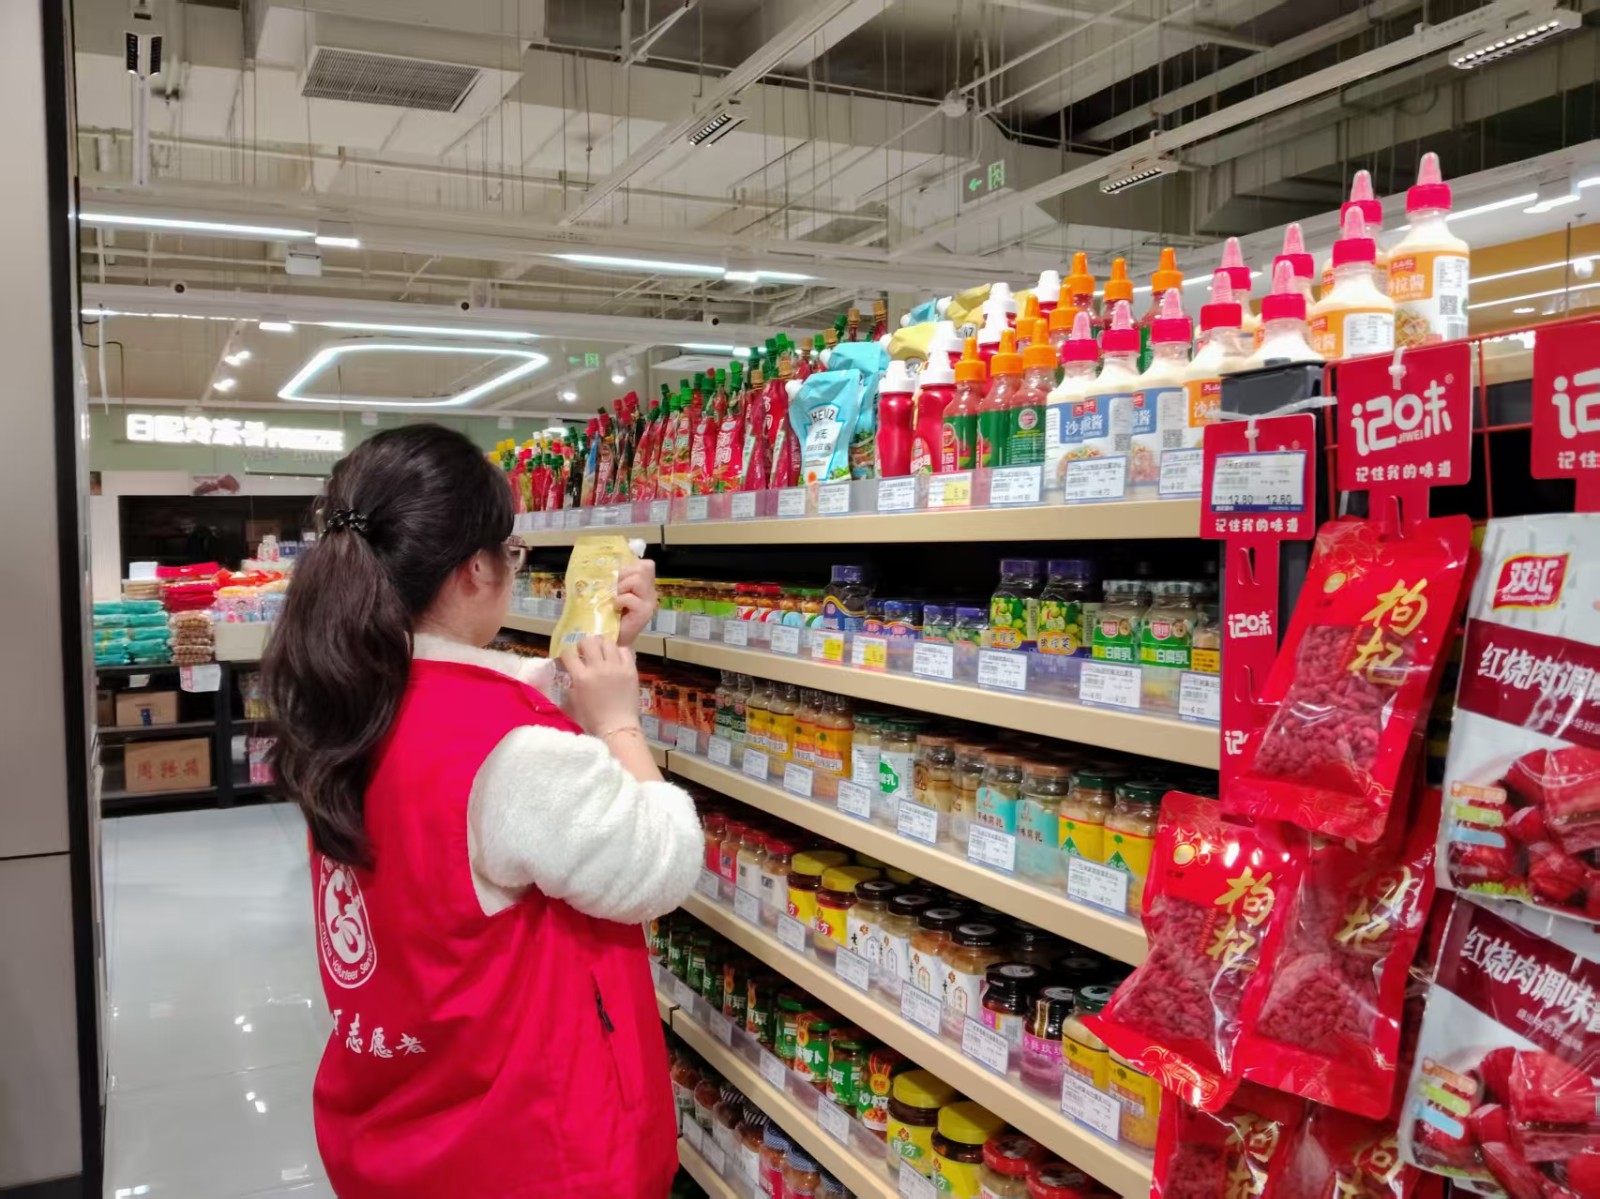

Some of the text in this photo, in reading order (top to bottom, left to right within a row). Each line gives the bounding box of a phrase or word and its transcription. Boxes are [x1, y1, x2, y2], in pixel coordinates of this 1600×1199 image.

[1355, 460, 1452, 482] 记住我的味道
[1215, 517, 1299, 533] 记住我的味道
[1502, 560, 1559, 594] 双汇
[1346, 578, 1428, 686] 枸杞
[1206, 866, 1276, 973] 枸杞
